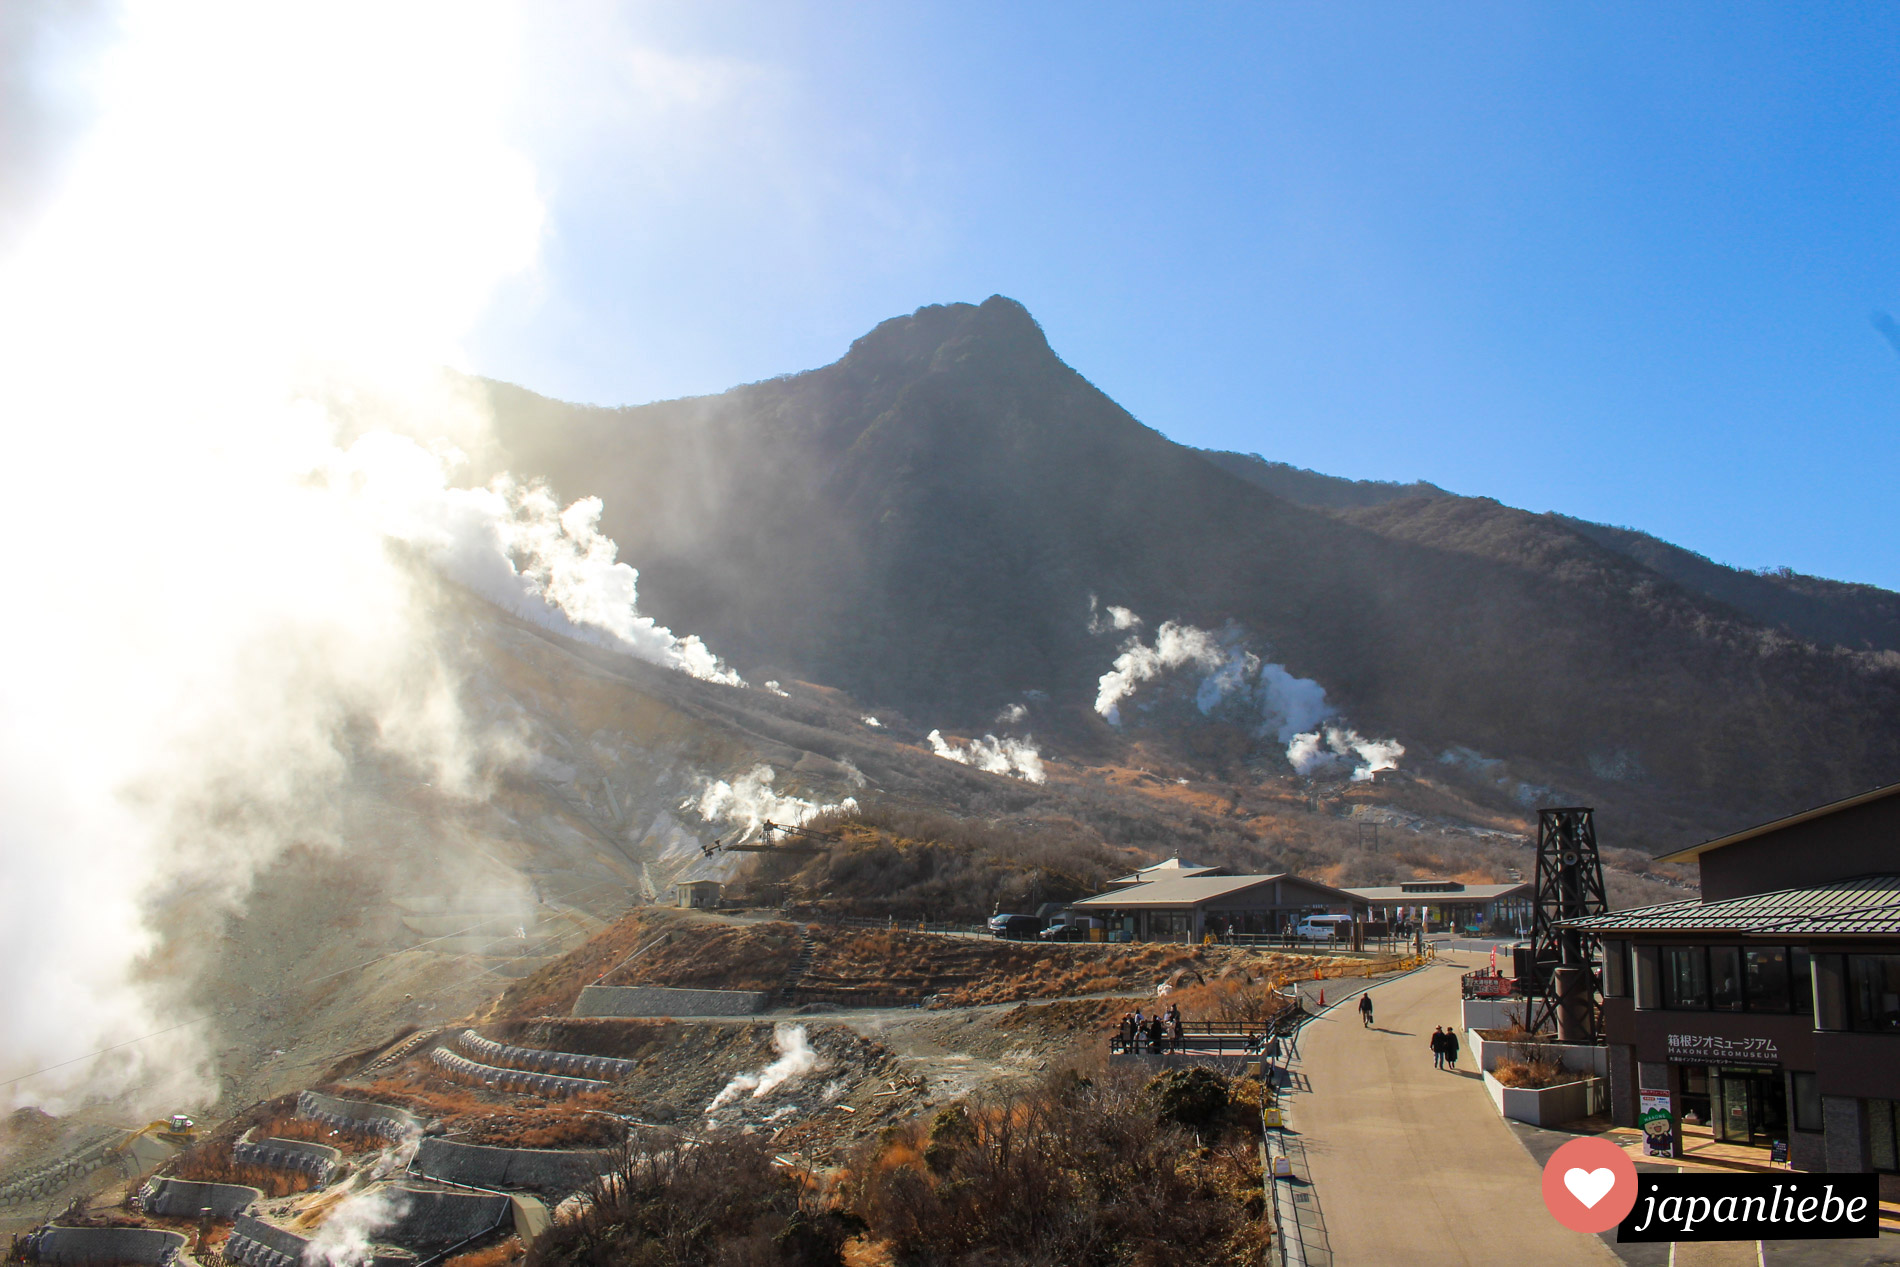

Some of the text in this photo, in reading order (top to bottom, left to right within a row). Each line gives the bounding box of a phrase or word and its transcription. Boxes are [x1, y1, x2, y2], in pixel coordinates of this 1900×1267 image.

[1668, 1034, 1777, 1051] 箱根ジオミュージアム
[1668, 1047, 1778, 1059] HAKONE GEOMUSEUM
